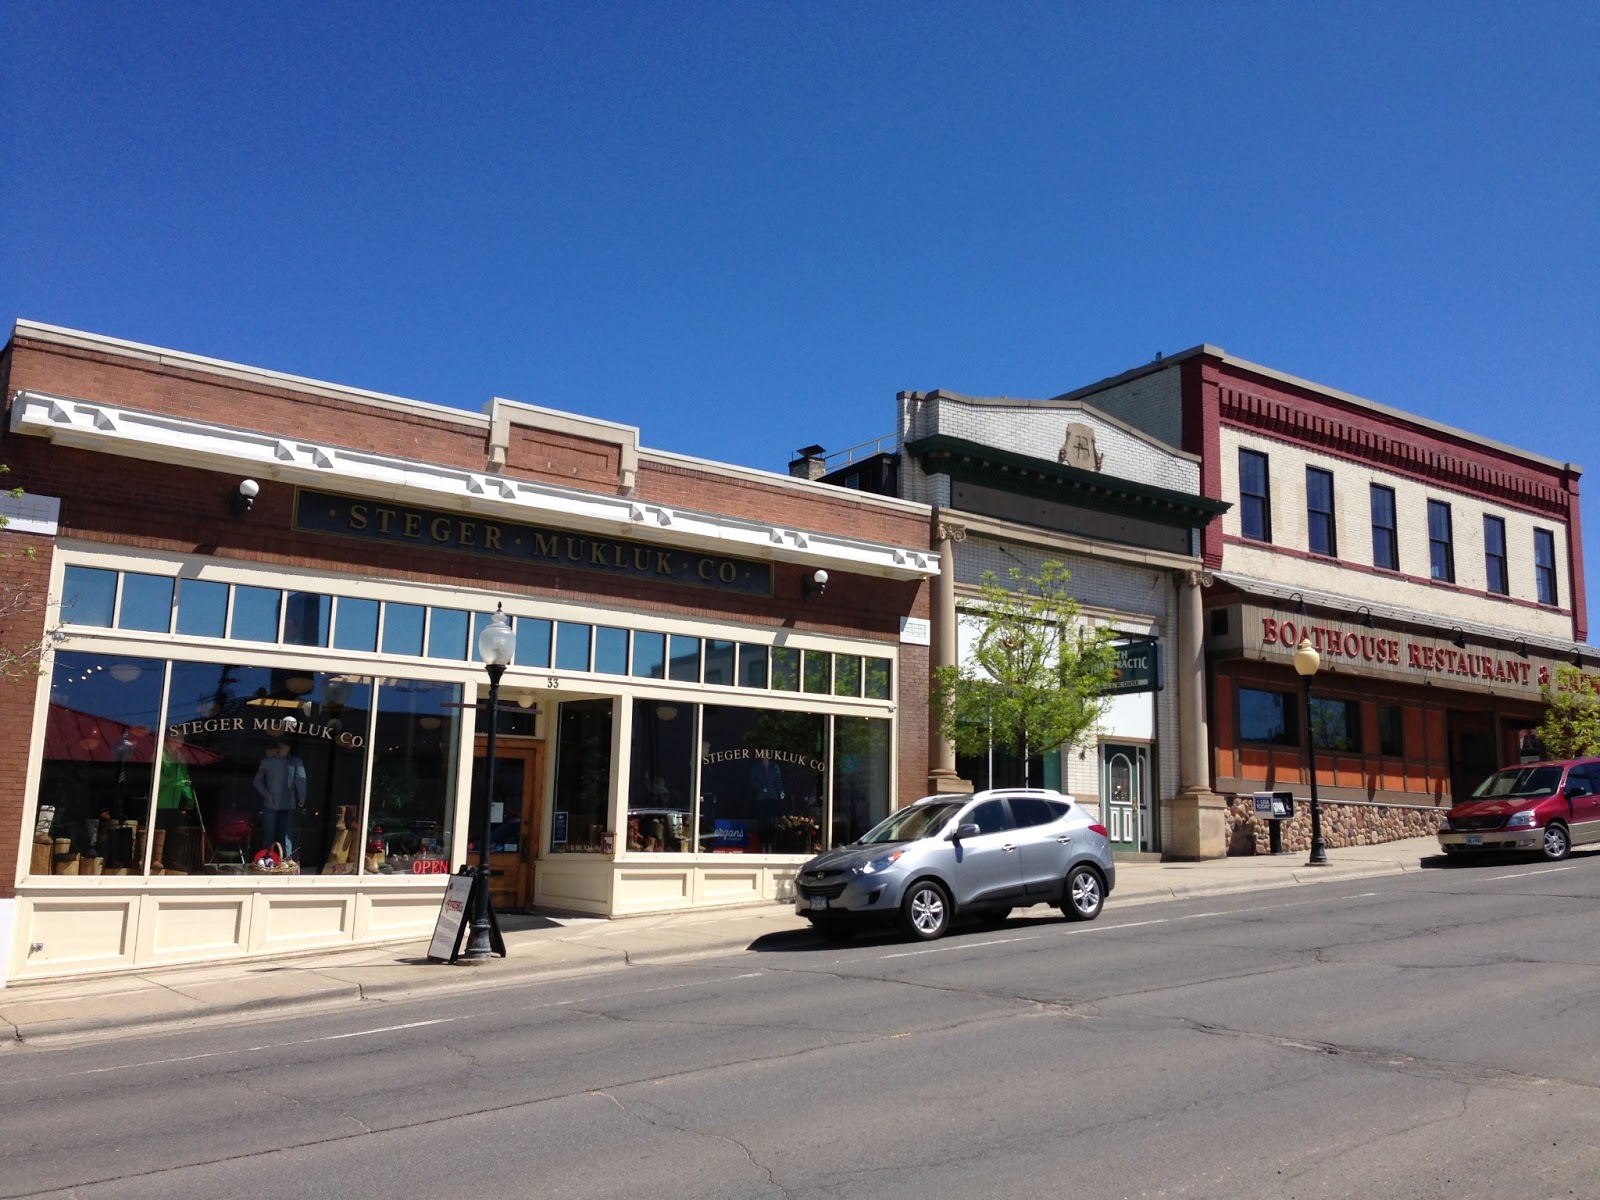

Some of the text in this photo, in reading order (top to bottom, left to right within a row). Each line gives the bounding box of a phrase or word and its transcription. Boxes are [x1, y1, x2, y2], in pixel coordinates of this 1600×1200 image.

[350, 504, 737, 583] STEGER MUKLUK CO
[1262, 617, 1400, 664] BOATHOUSE
[1408, 643, 1531, 684] RESTAURANT
[1538, 665, 1550, 685] &
[547, 677, 559, 688] 33
[169, 718, 365, 748] STEGER MUKLUK CO.
[702, 748, 750, 765] STEGER
[754, 748, 806, 766] MUKLUK
[412, 861, 449, 874] OPEN
